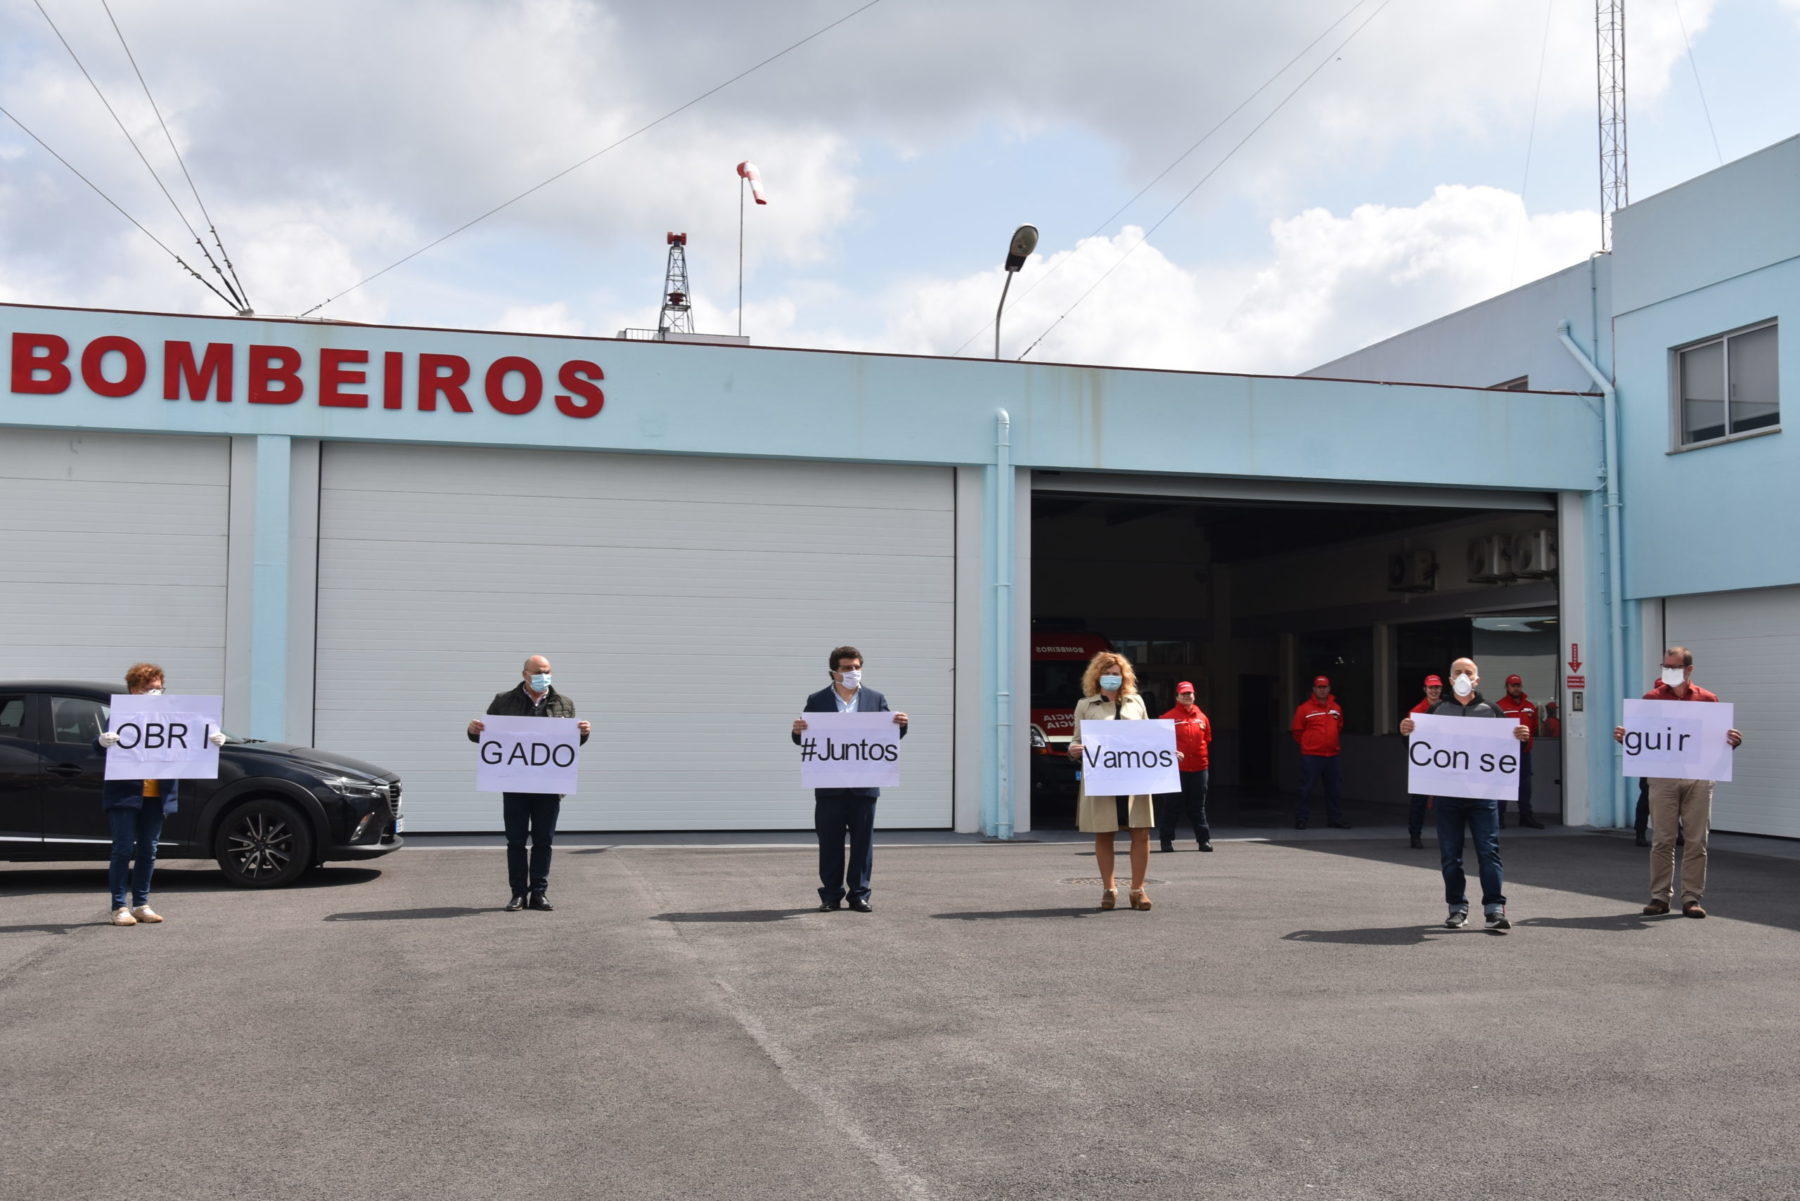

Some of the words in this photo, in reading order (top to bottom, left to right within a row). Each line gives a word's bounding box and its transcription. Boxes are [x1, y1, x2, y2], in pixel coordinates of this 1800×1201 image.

[11, 332, 605, 418] BOMBEIROS
[116, 722, 188, 750] OBR
[800, 737, 898, 763] #Juntos
[1624, 726, 1691, 757] guir
[481, 740, 576, 768] GADO
[1083, 744, 1173, 769] Vamos
